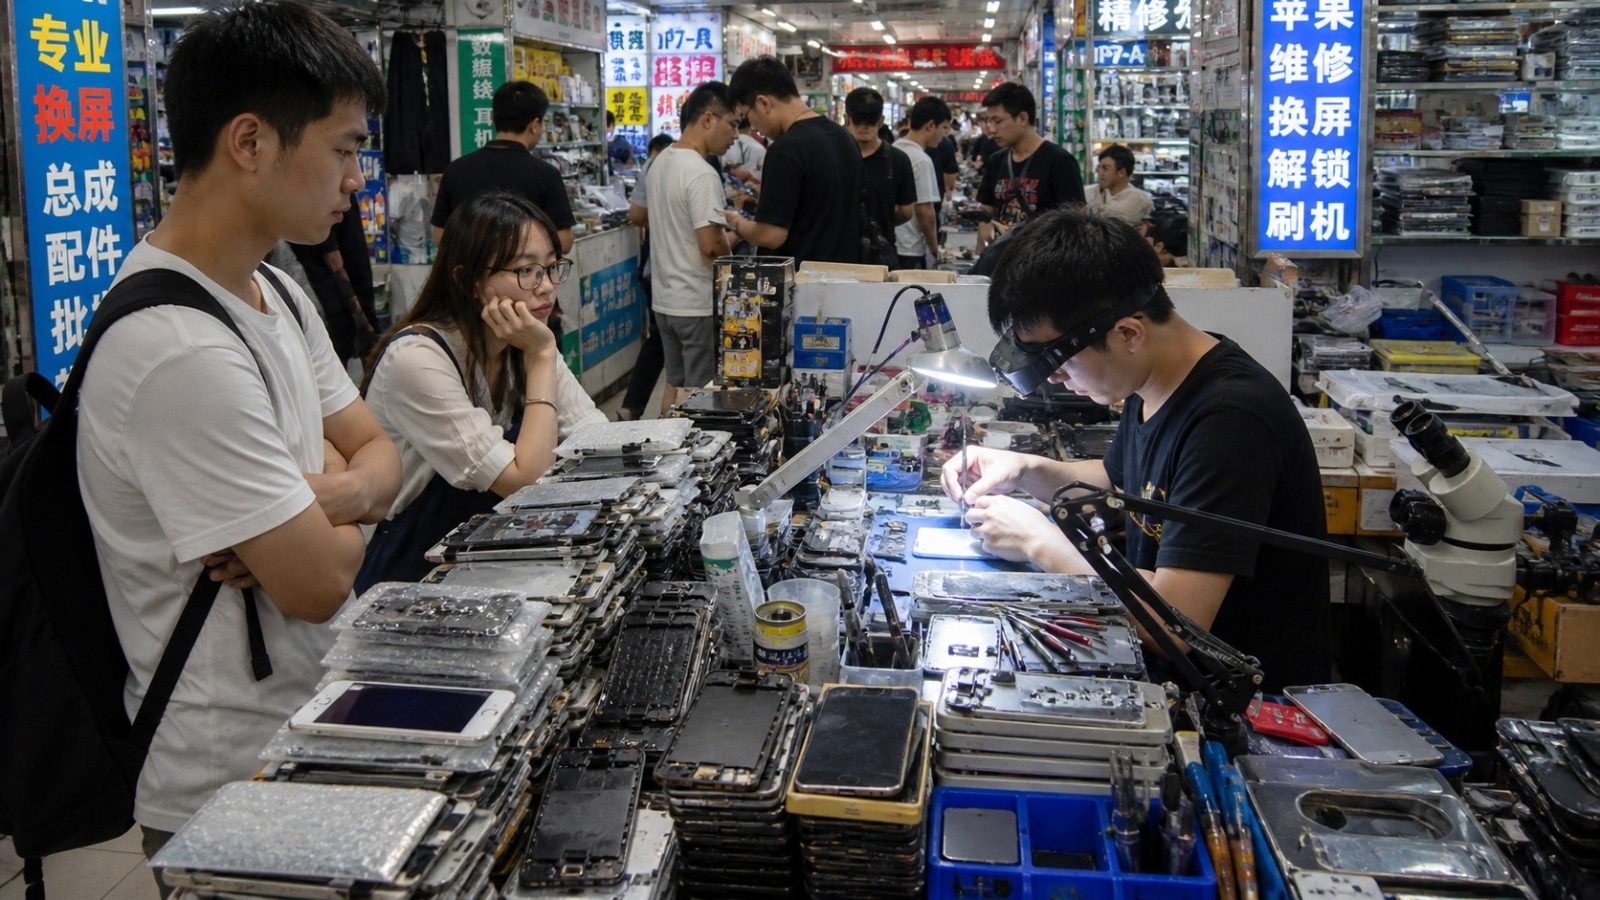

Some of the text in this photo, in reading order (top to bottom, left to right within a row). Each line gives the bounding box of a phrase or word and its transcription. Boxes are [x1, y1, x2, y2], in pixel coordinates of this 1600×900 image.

[1271, 0, 1354, 31] 苹果
[30, 13, 111, 73] 专业
[1093, 44, 1145, 65] IP7-A
[1269, 42, 1354, 84] 维修
[33, 84, 115, 143] 换屏
[1268, 96, 1352, 137] 换屏
[43, 160, 118, 217] 总成
[1267, 149, 1351, 189] 解锁
[1266, 201, 1350, 242] 刷机
[46, 224, 122, 286] 配件
[51, 290, 108, 355] 批
